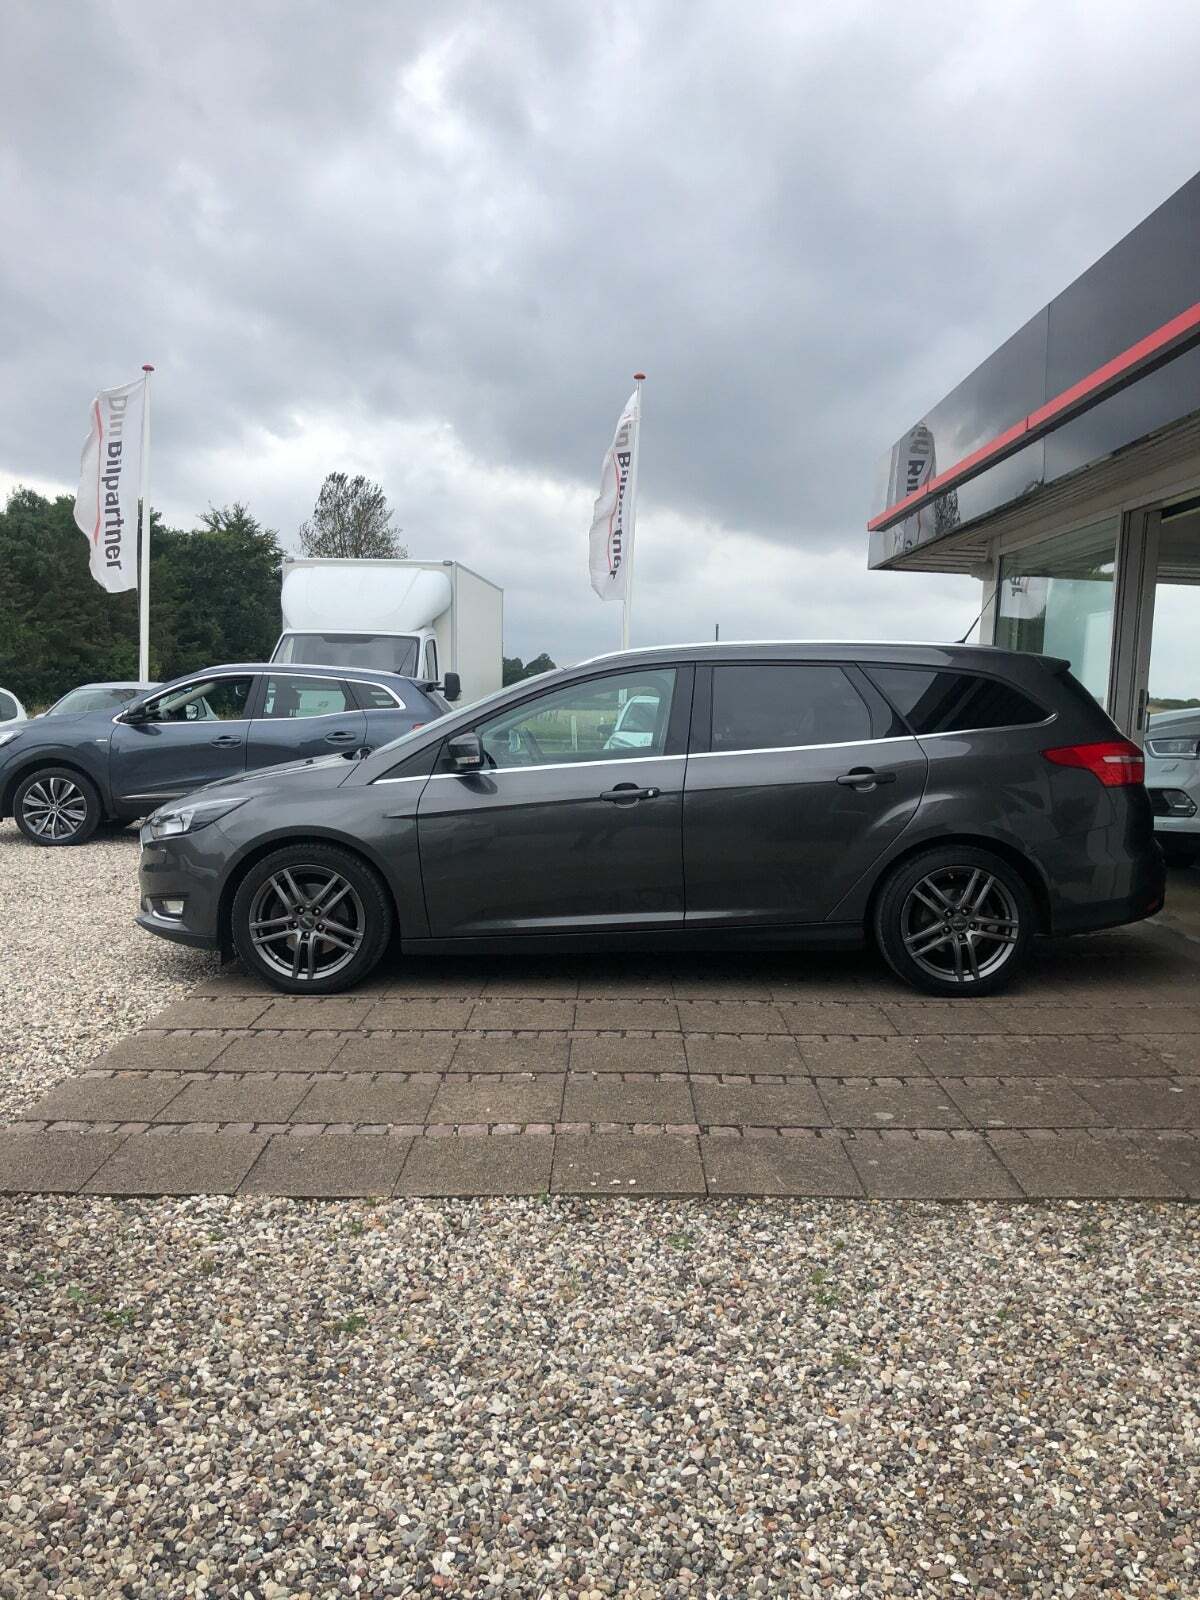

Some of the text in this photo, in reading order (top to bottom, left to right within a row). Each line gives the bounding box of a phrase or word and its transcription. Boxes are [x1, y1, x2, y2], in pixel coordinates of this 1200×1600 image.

[101, 395, 128, 570] Din Bilpartner
[615, 422, 632, 447] in
